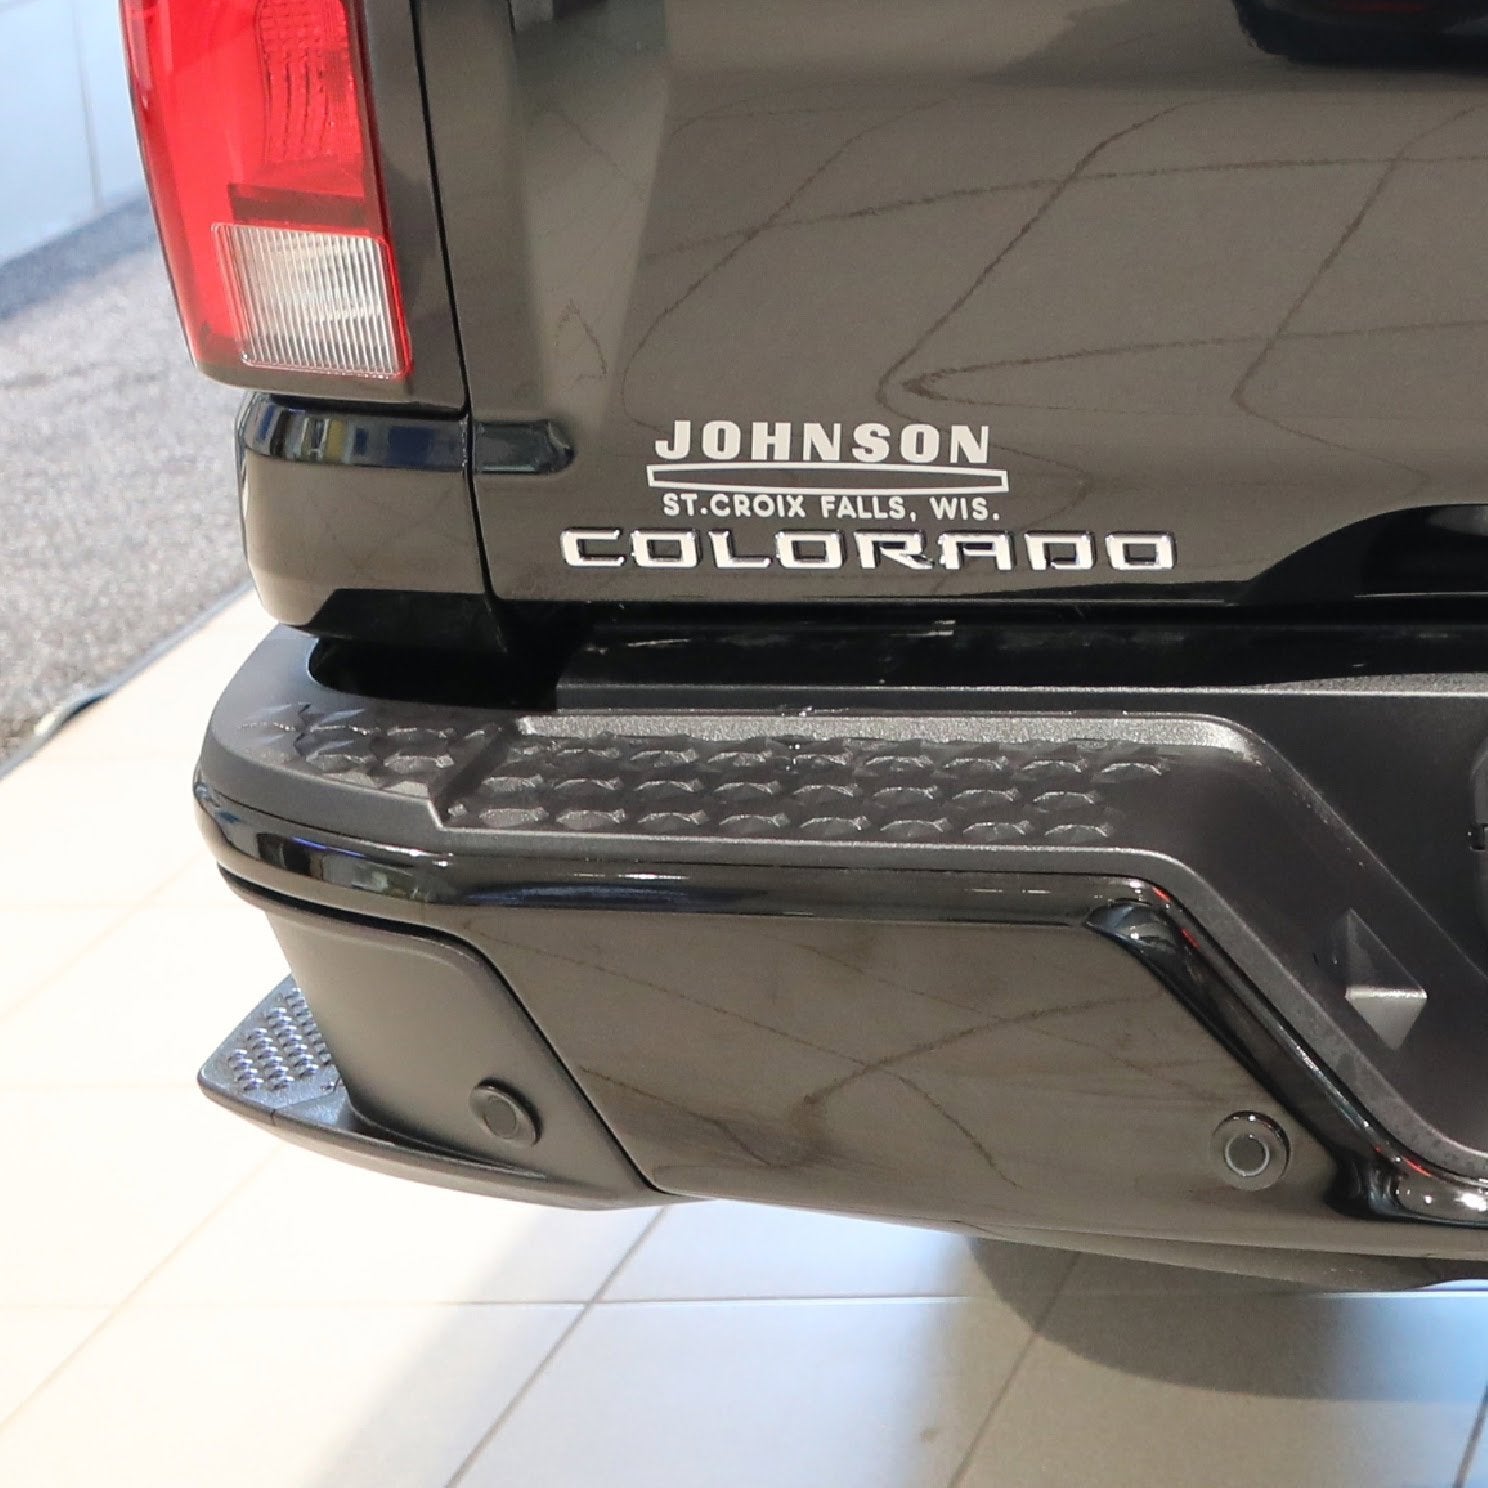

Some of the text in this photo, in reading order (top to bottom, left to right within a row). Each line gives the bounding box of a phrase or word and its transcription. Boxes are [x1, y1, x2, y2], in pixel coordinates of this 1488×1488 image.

[655, 420, 990, 464] JOHNSON
[821, 495, 917, 522] FALLS,
[930, 497, 1000, 522] WIS.
[560, 528, 1177, 572] COLORADO
